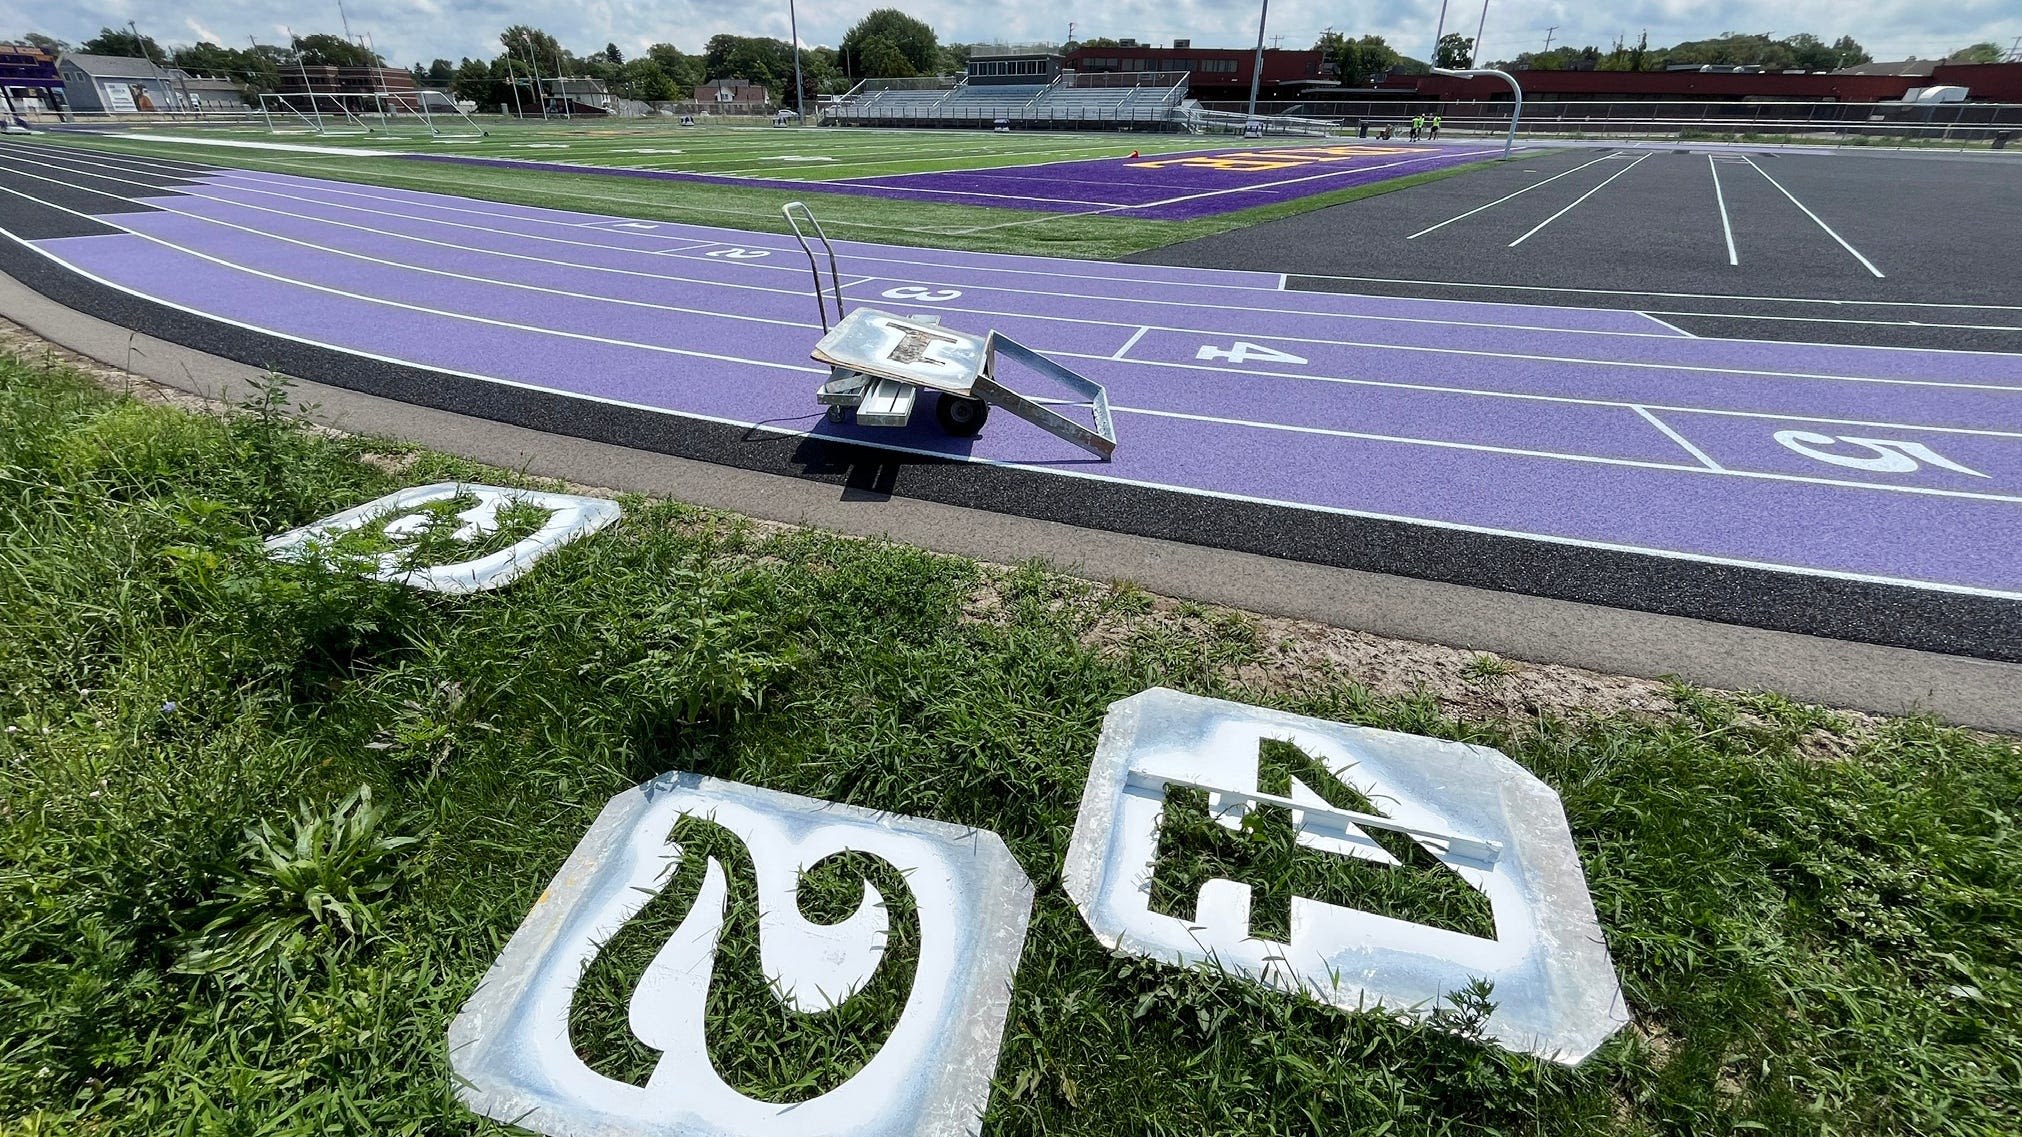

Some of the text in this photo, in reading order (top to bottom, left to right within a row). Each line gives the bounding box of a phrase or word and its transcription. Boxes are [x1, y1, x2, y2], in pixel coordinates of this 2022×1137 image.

[705, 248, 771, 258] 2
[881, 286, 962, 302] 3
[1195, 341, 1309, 365] 4
[1773, 430, 1993, 479] 5
[1147, 737, 1498, 946] 4
[567, 813, 922, 1104] 2
